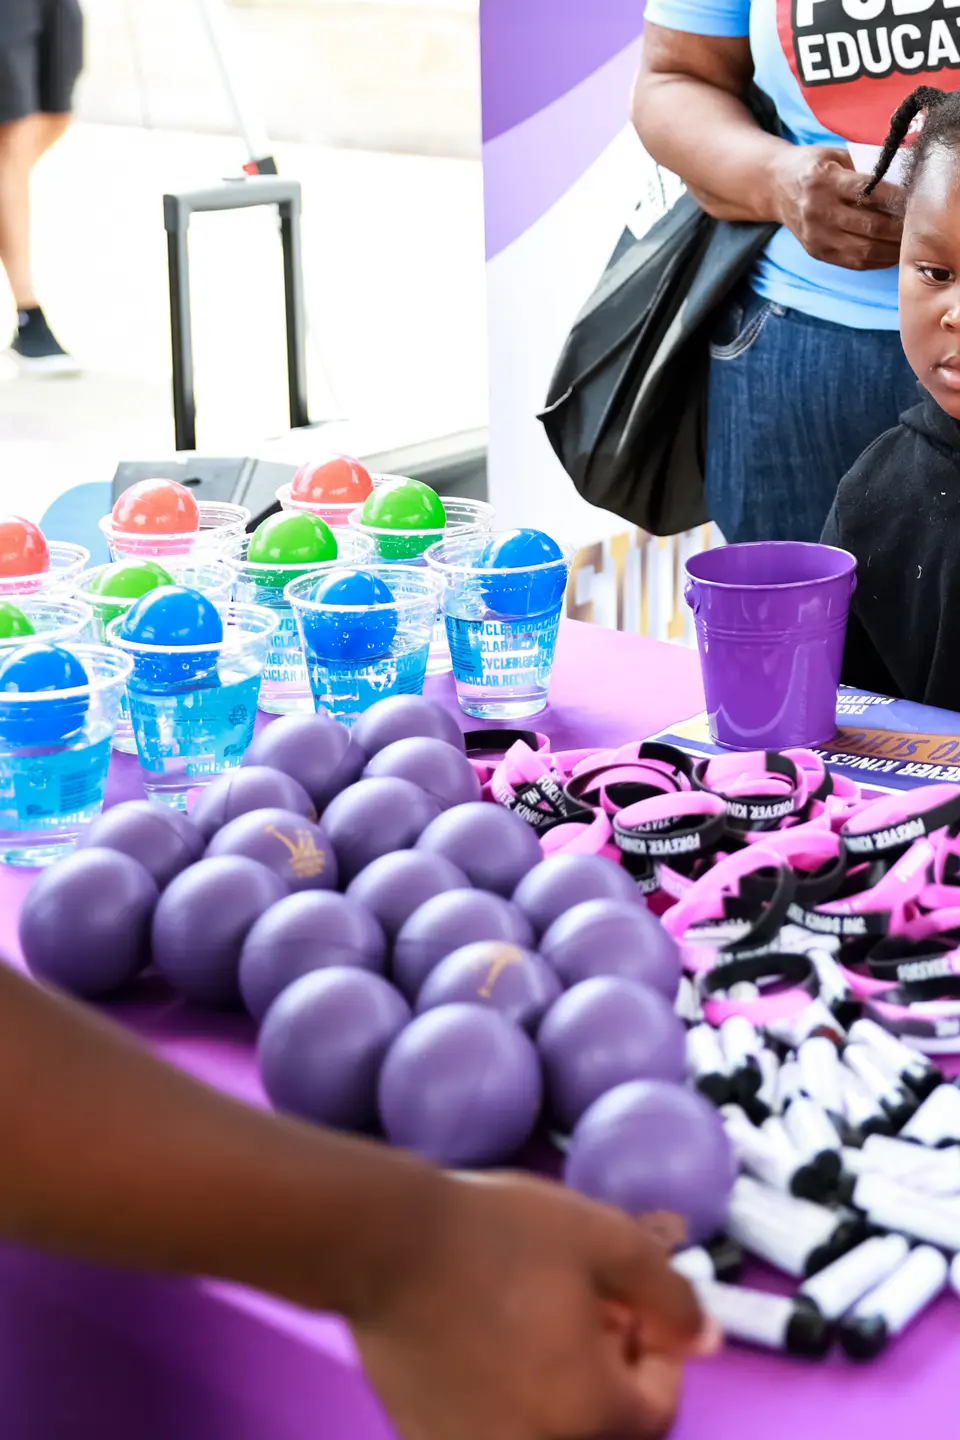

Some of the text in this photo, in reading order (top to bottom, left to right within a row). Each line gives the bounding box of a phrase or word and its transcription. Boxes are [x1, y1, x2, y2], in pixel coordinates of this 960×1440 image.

[836, 732, 930, 758] SCHO
[823, 753, 900, 773] KINGS
[722, 798, 795, 820] FOREVER KIN
[647, 832, 701, 855] FOREVER
